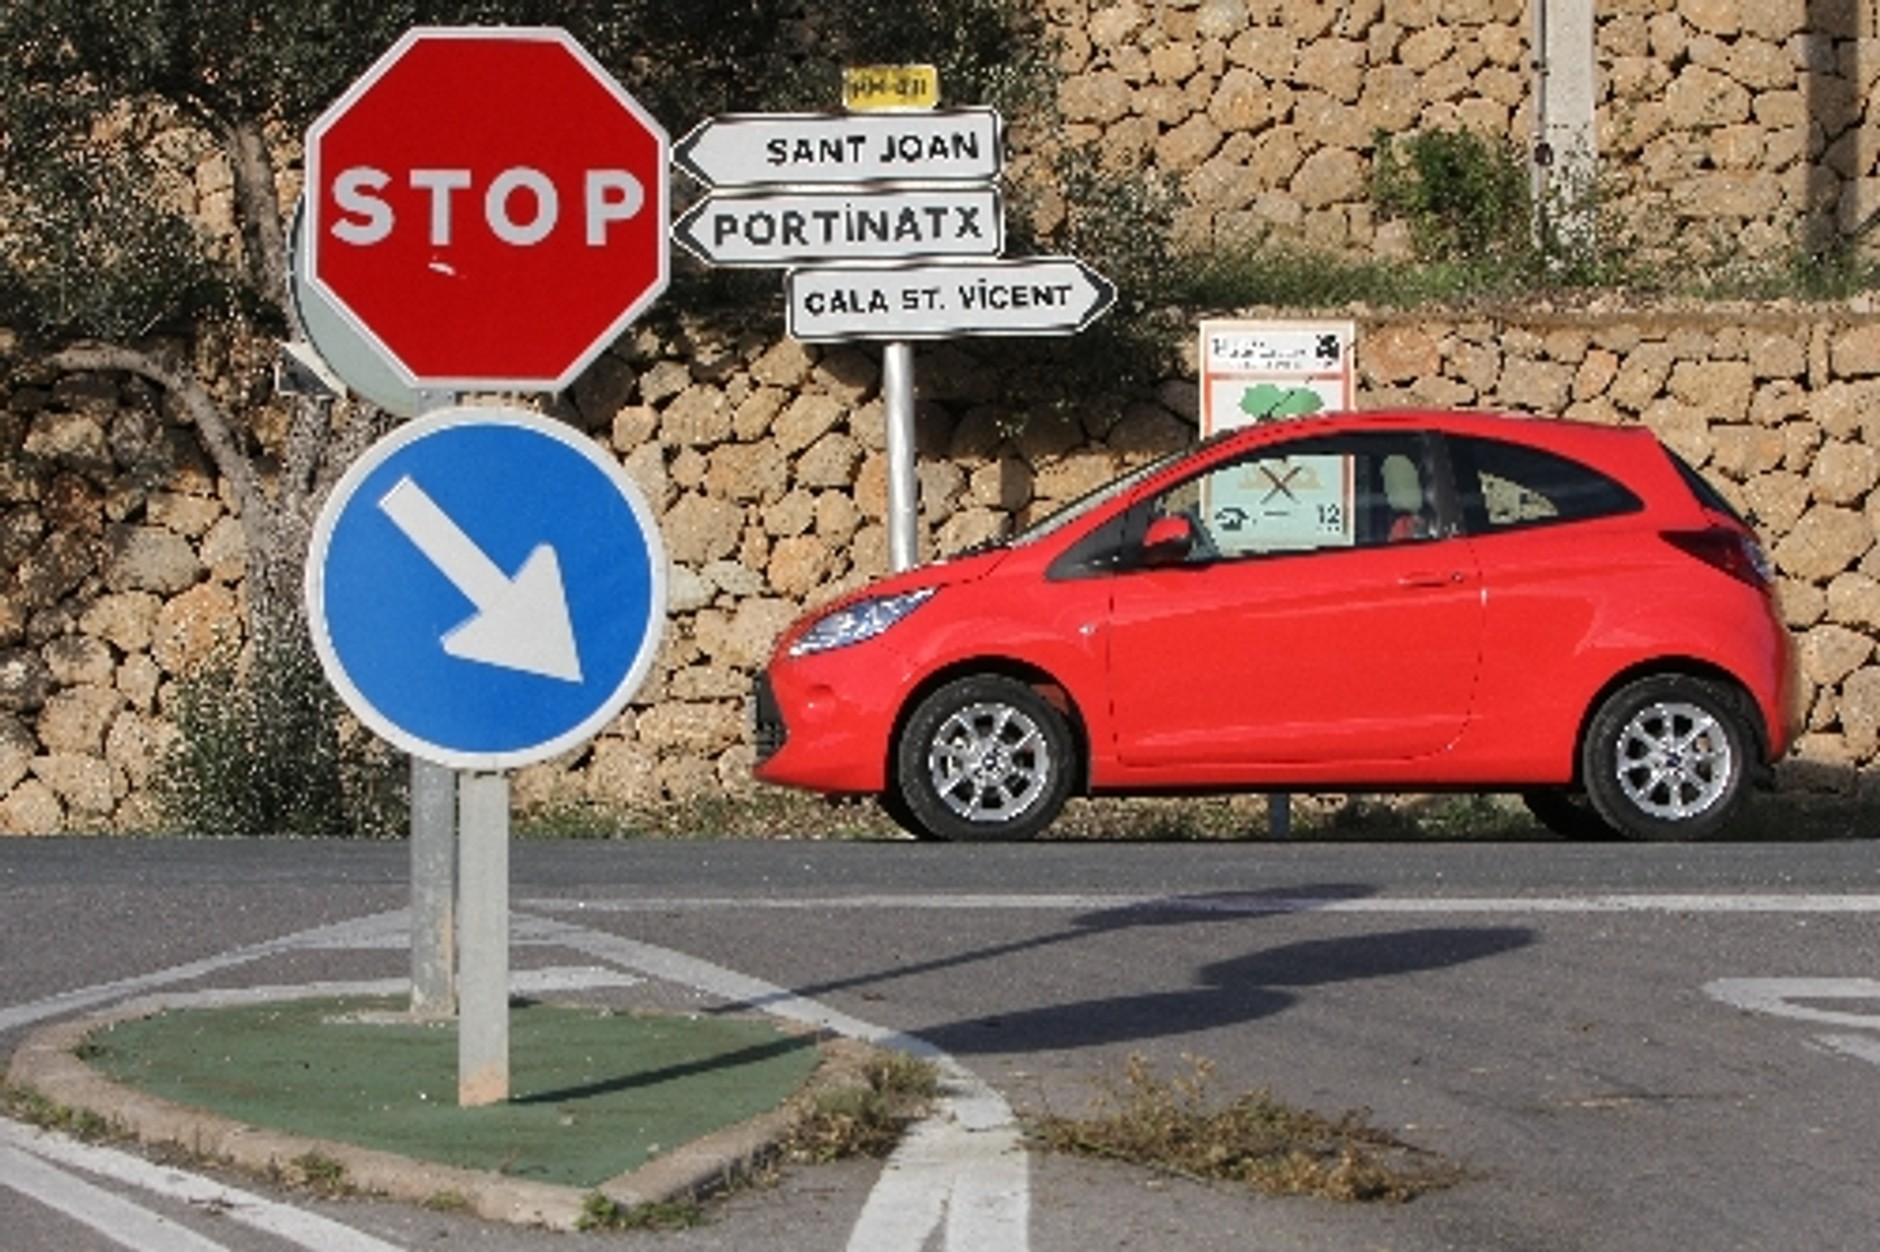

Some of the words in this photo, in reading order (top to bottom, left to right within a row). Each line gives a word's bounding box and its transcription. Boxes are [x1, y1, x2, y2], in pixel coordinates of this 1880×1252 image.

[766, 134, 867, 165] SANT
[879, 131, 979, 162] JOAN
[330, 165, 646, 247] STOP
[804, 289, 889, 316] CALA
[901, 287, 946, 311] ST.
